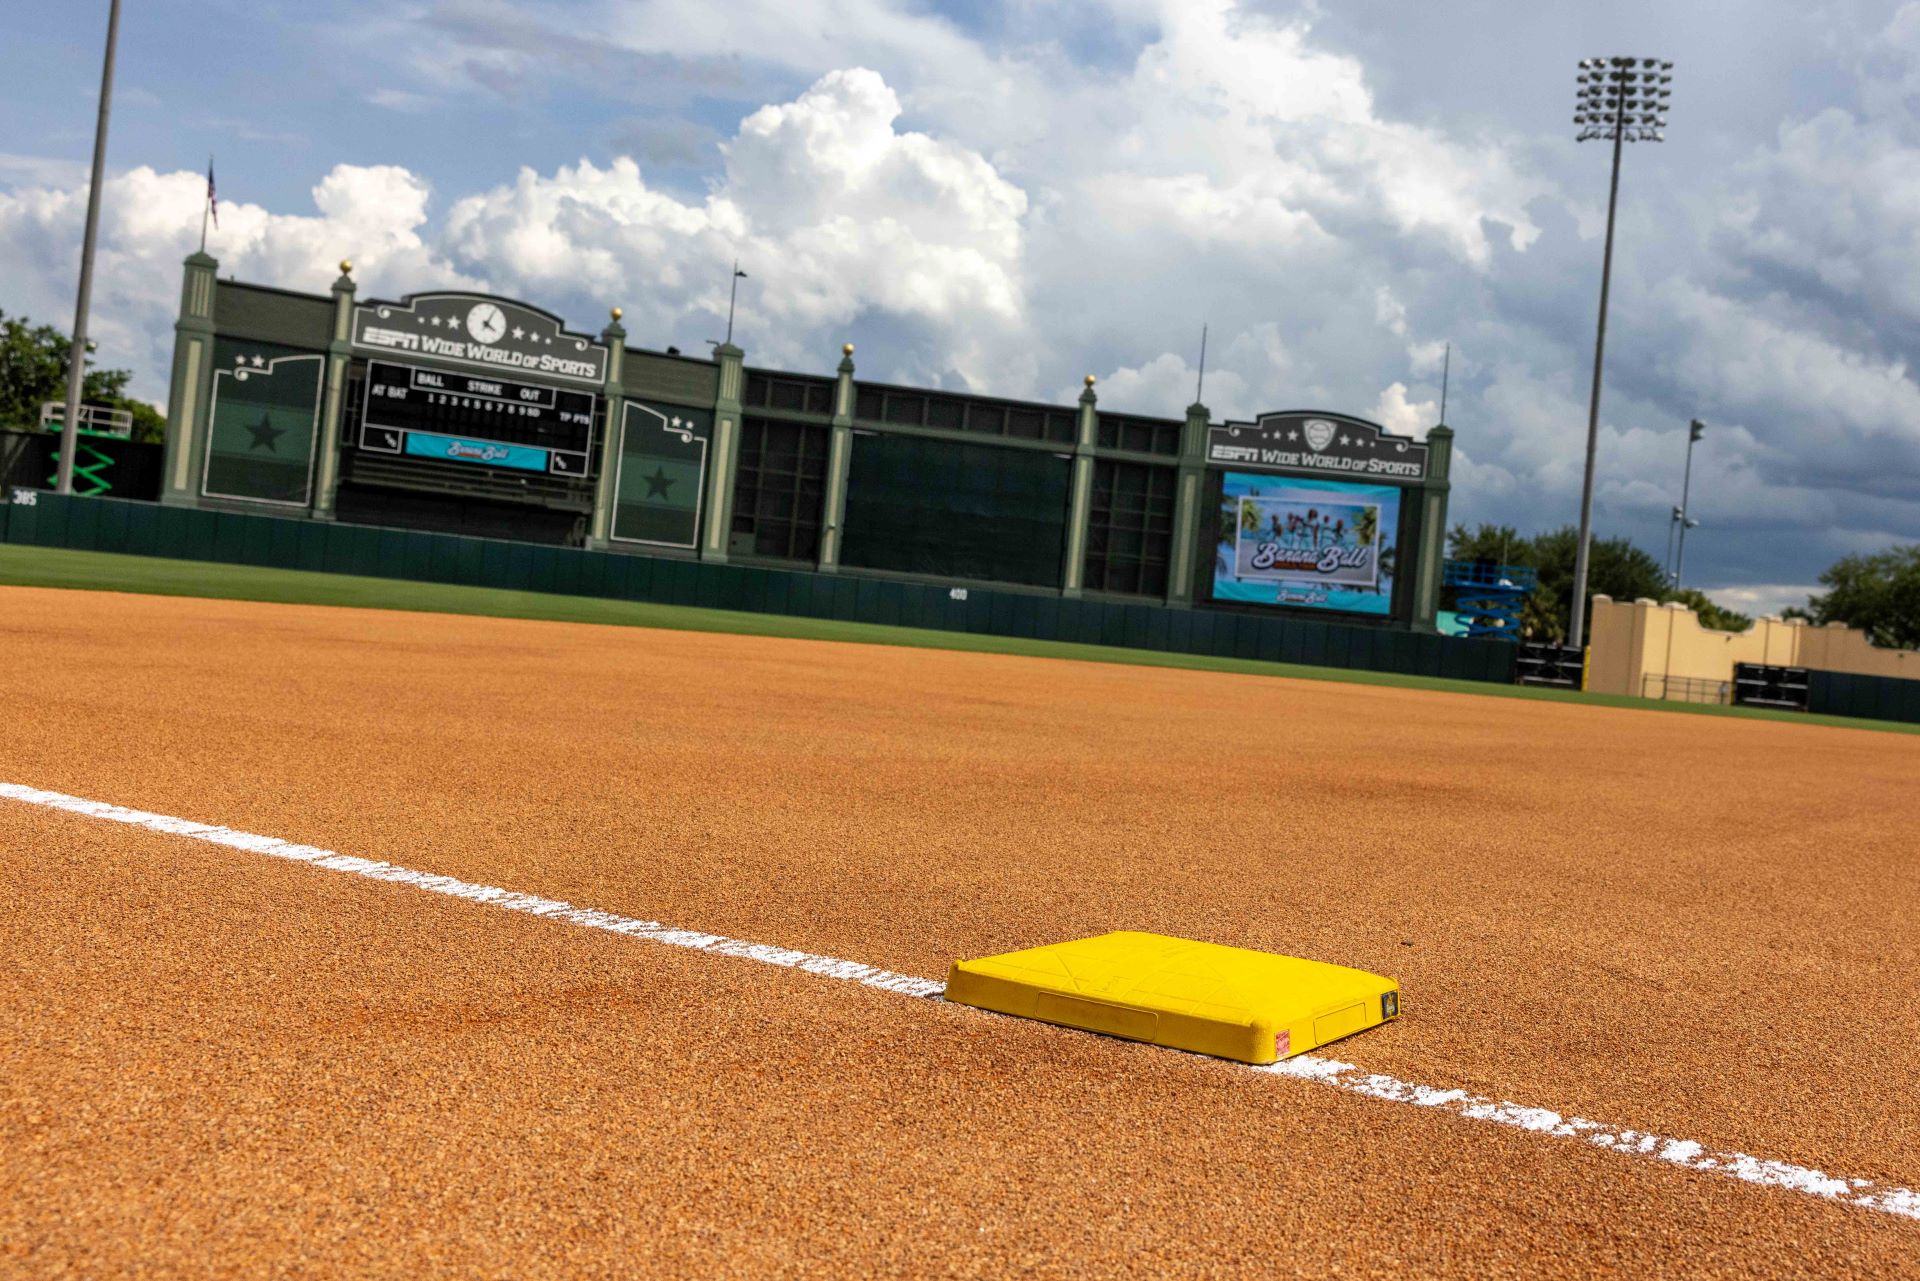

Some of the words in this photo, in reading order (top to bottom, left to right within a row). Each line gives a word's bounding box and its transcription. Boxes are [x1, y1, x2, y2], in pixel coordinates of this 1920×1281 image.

[362, 326, 420, 350] ESPN
[421, 335, 464, 358] WIDE
[466, 344, 523, 367] WORLD
[523, 356, 540, 369] OF
[539, 354, 596, 377] SPORTS
[371, 384, 386, 396] AT
[387, 386, 408, 399] BAT
[417, 372, 445, 387] BALL
[467, 380, 503, 395] STRIKE
[520, 388, 541, 401] OUT
[428, 393, 434, 403] 1
[439, 394, 447, 405] 2
[1211, 445, 1258, 461] ESPN
[1261, 449, 1299, 465] WIDE
[1301, 452, 1351, 470] WORLD
[1352, 459, 1368, 471] OF
[1367, 458, 1421, 476] SPORTS
[1252, 543, 1318, 569] Banana
[1316, 546, 1367, 573] Ball
